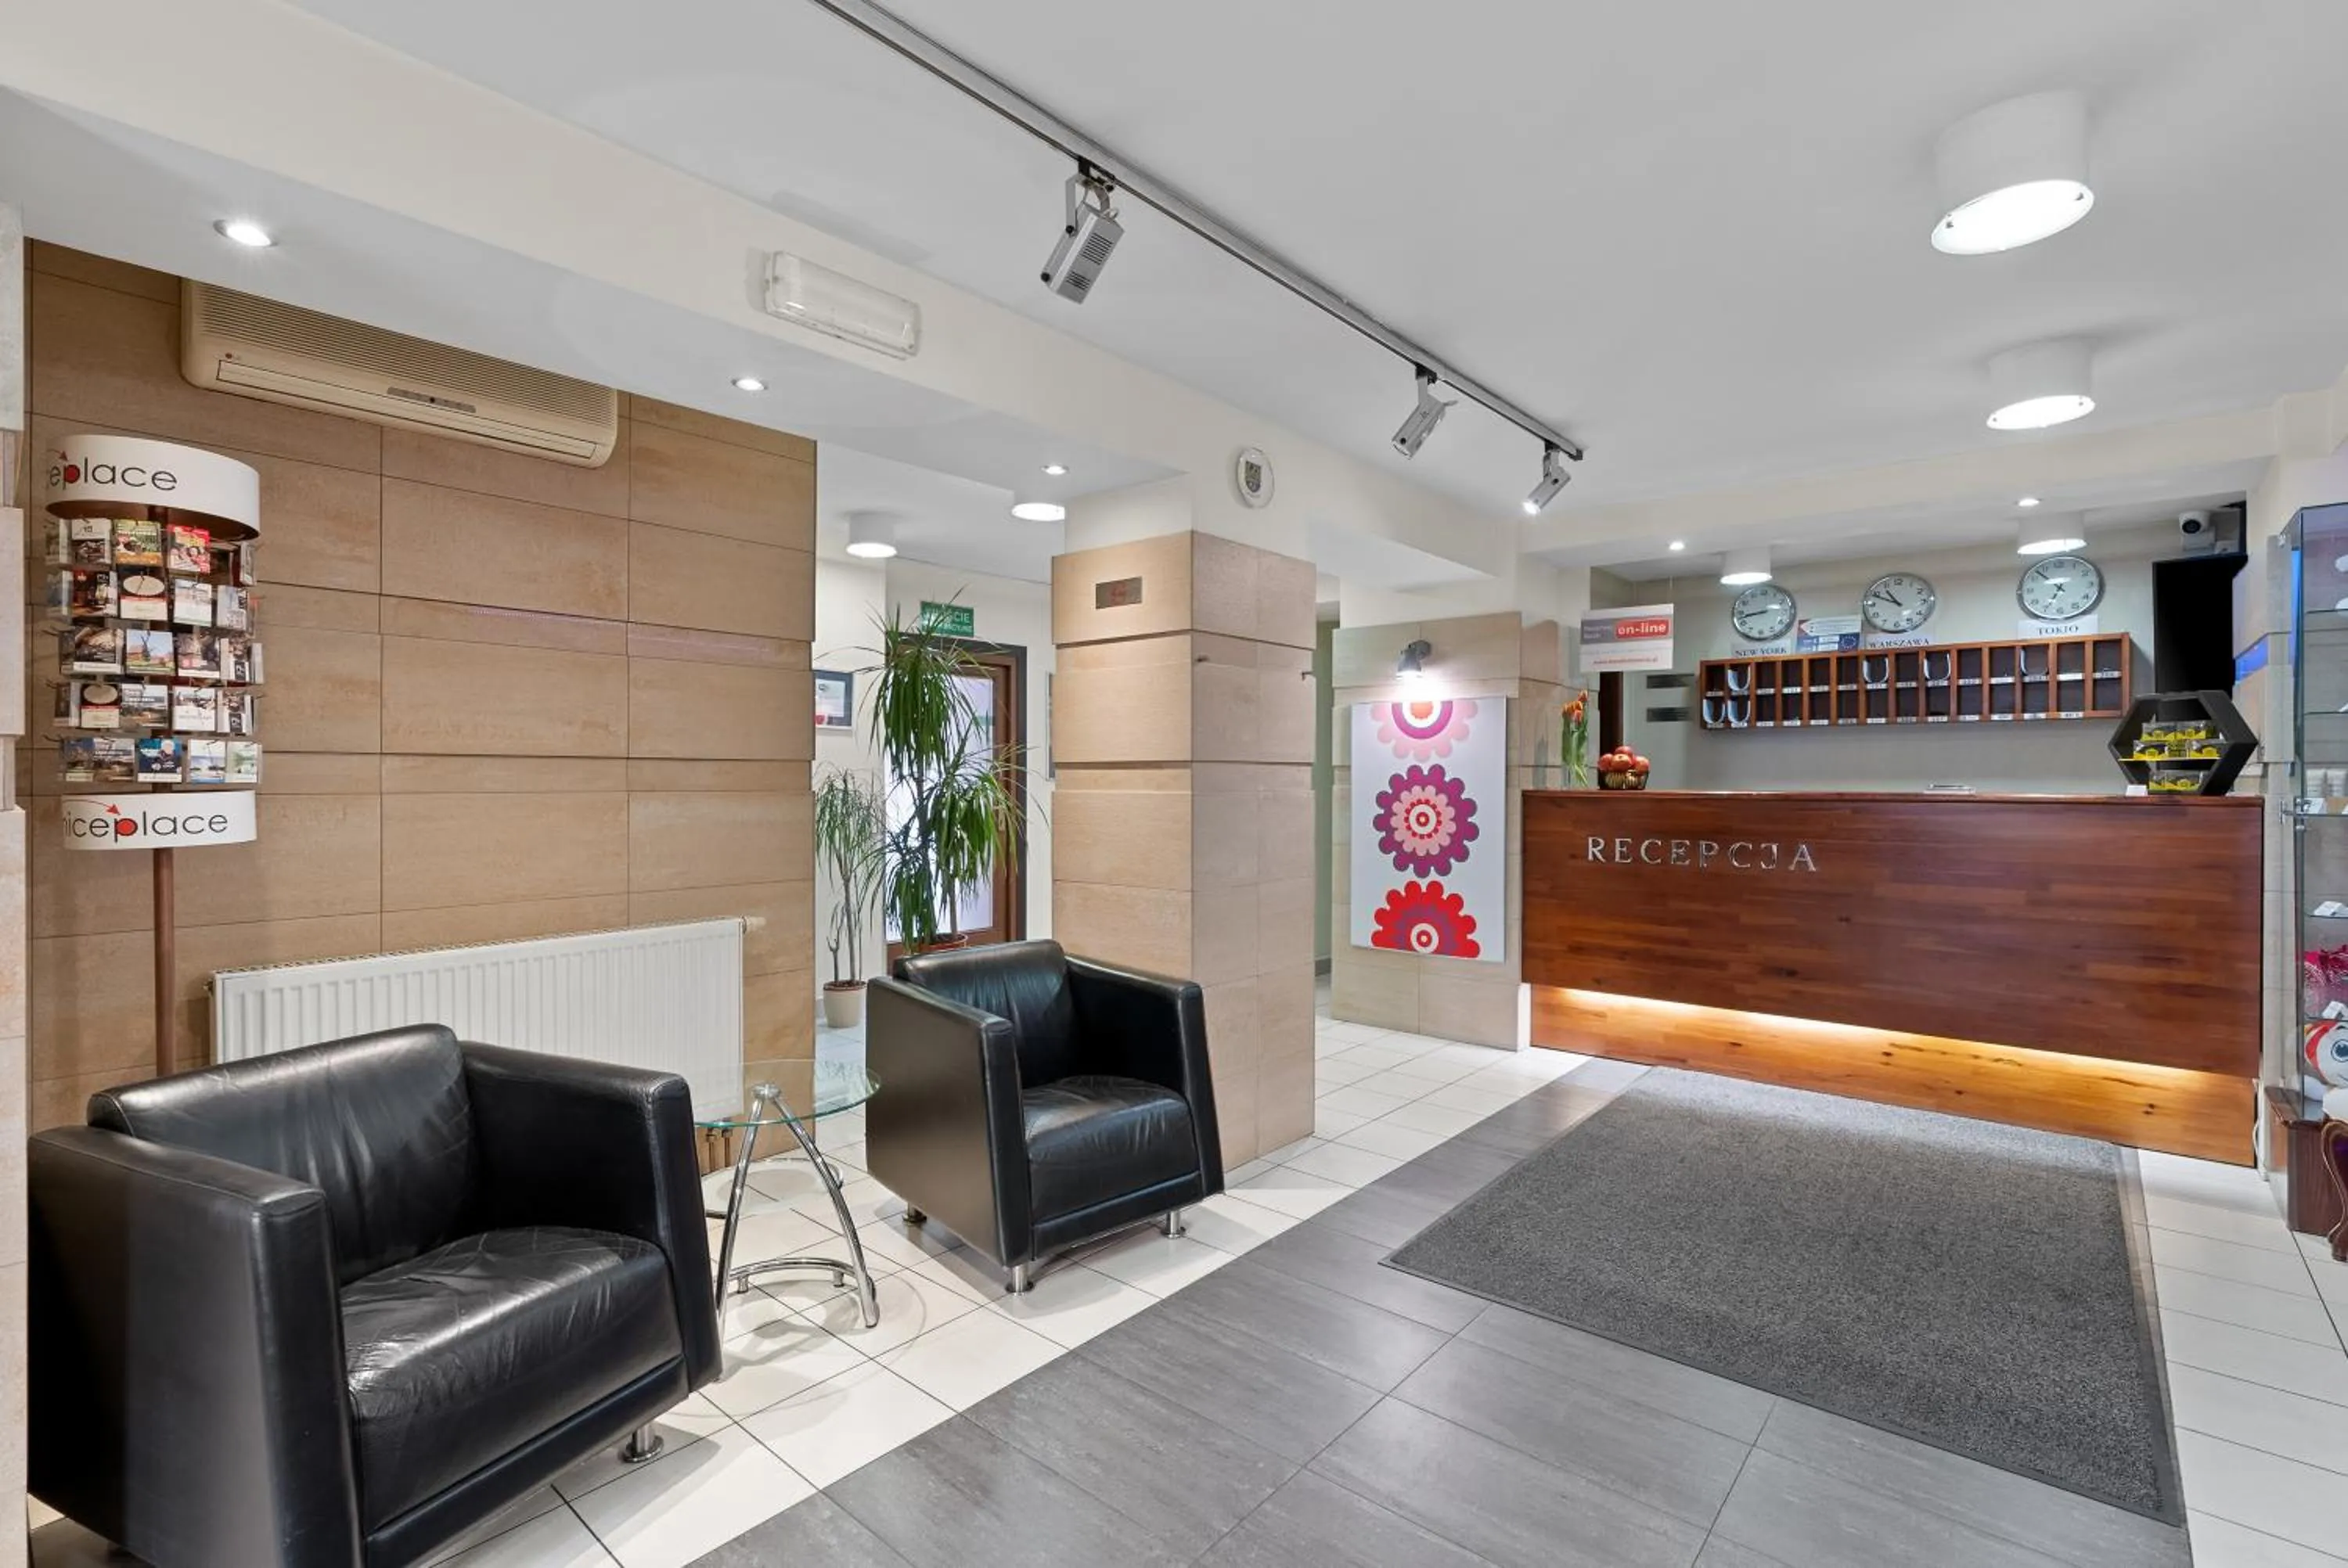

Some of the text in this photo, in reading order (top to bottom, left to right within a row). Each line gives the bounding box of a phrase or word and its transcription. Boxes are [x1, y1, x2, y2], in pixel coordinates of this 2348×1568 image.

[1618, 622, 1666, 636] on-line
[2038, 625, 2079, 635] TOKIO
[1868, 638, 1929, 649] WARSZAWA
[1587, 836, 1817, 872] RECEPCJA
